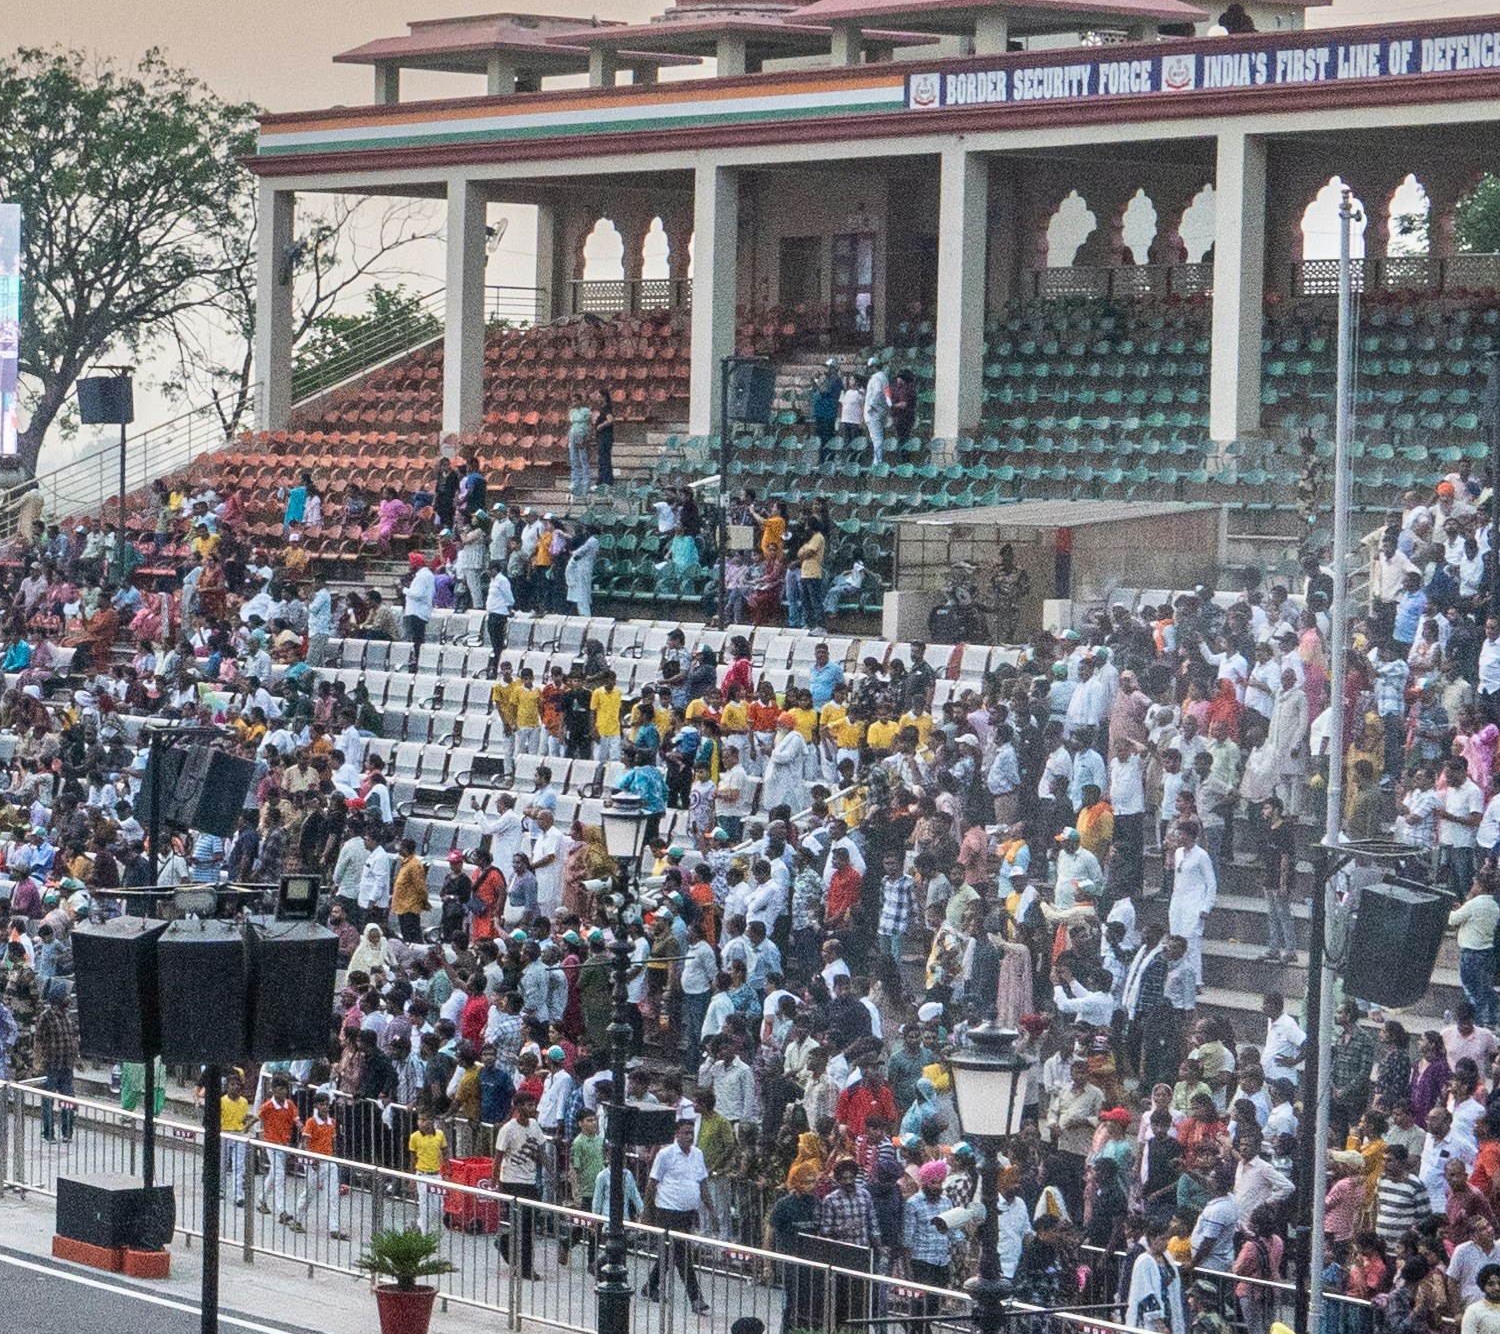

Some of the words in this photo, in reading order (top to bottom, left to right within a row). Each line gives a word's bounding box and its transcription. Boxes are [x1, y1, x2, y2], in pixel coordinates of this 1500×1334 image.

[945, 71, 1007, 106] BORDER
[1012, 64, 1091, 101] SECURITY
[1098, 60, 1152, 96] FORCE
[1202, 52, 1268, 89] INDIA'S
[1275, 47, 1331, 84] FIRST
[1336, 44, 1381, 79] LINE
[1388, 41, 1414, 75] OF
